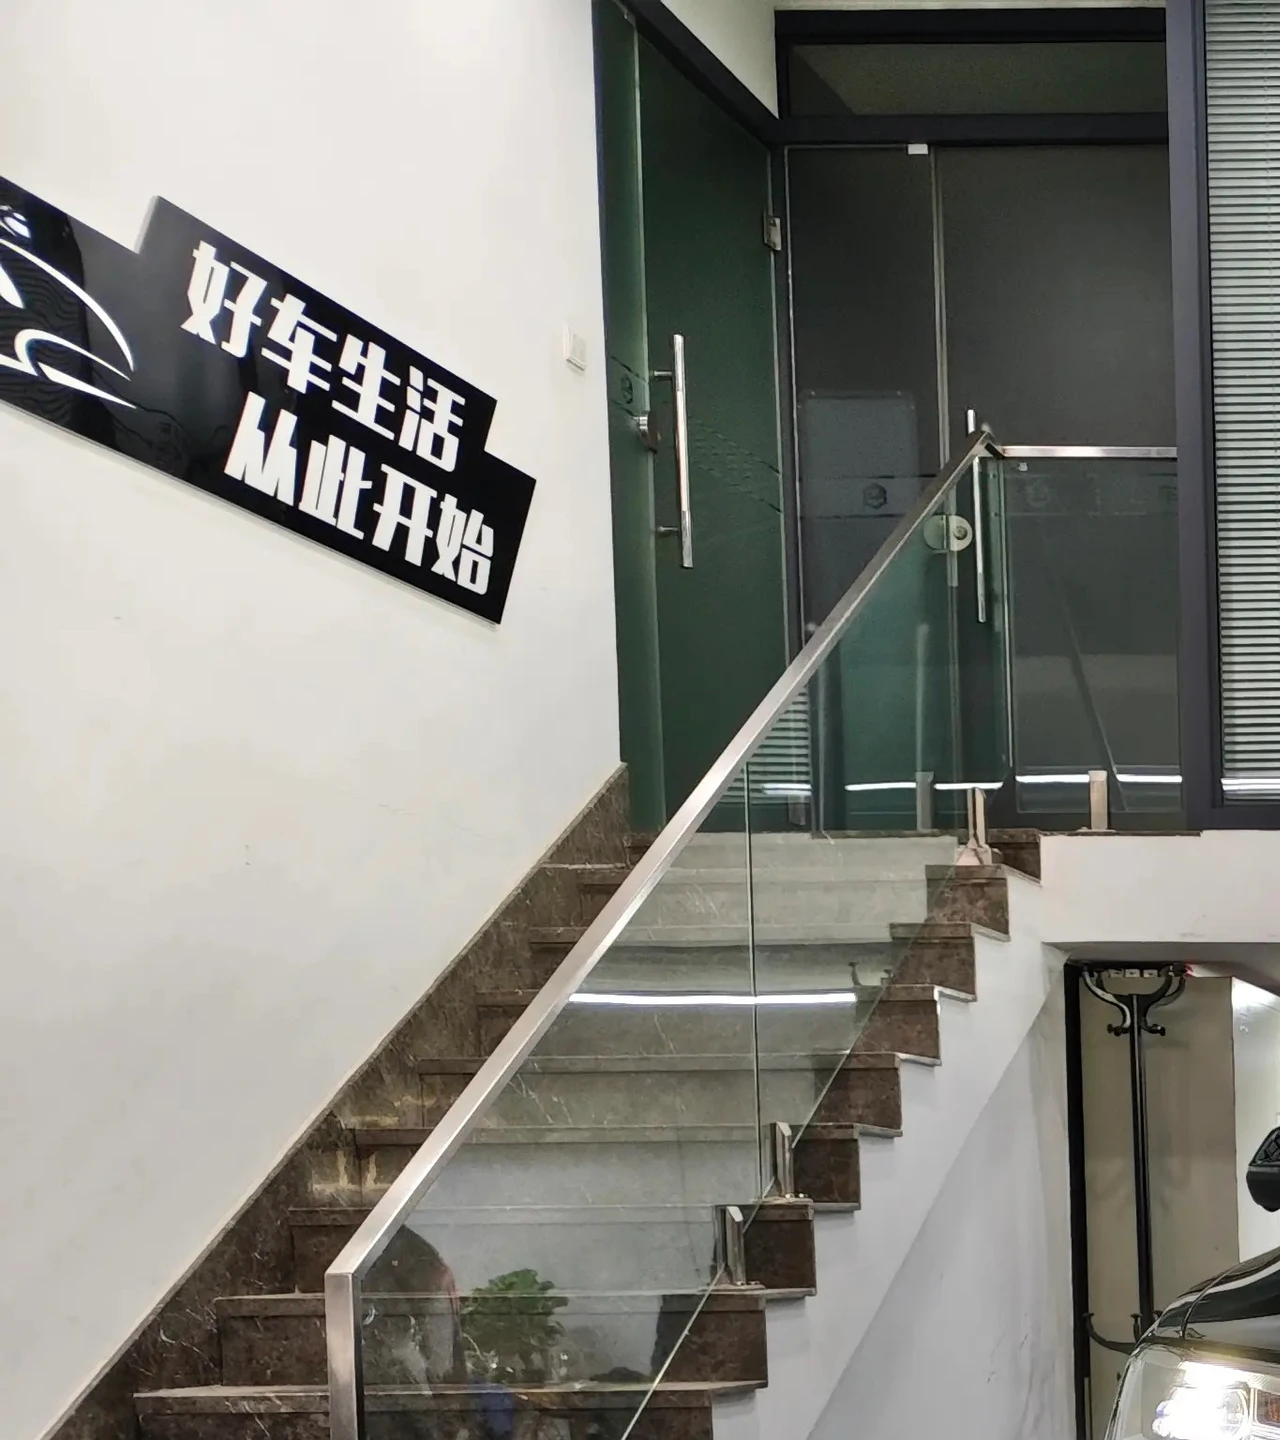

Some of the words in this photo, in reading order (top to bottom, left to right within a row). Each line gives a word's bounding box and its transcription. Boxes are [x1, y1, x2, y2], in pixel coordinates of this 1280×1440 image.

[180, 240, 466, 473] 好车生活
[224, 391, 495, 595] 从此开始
